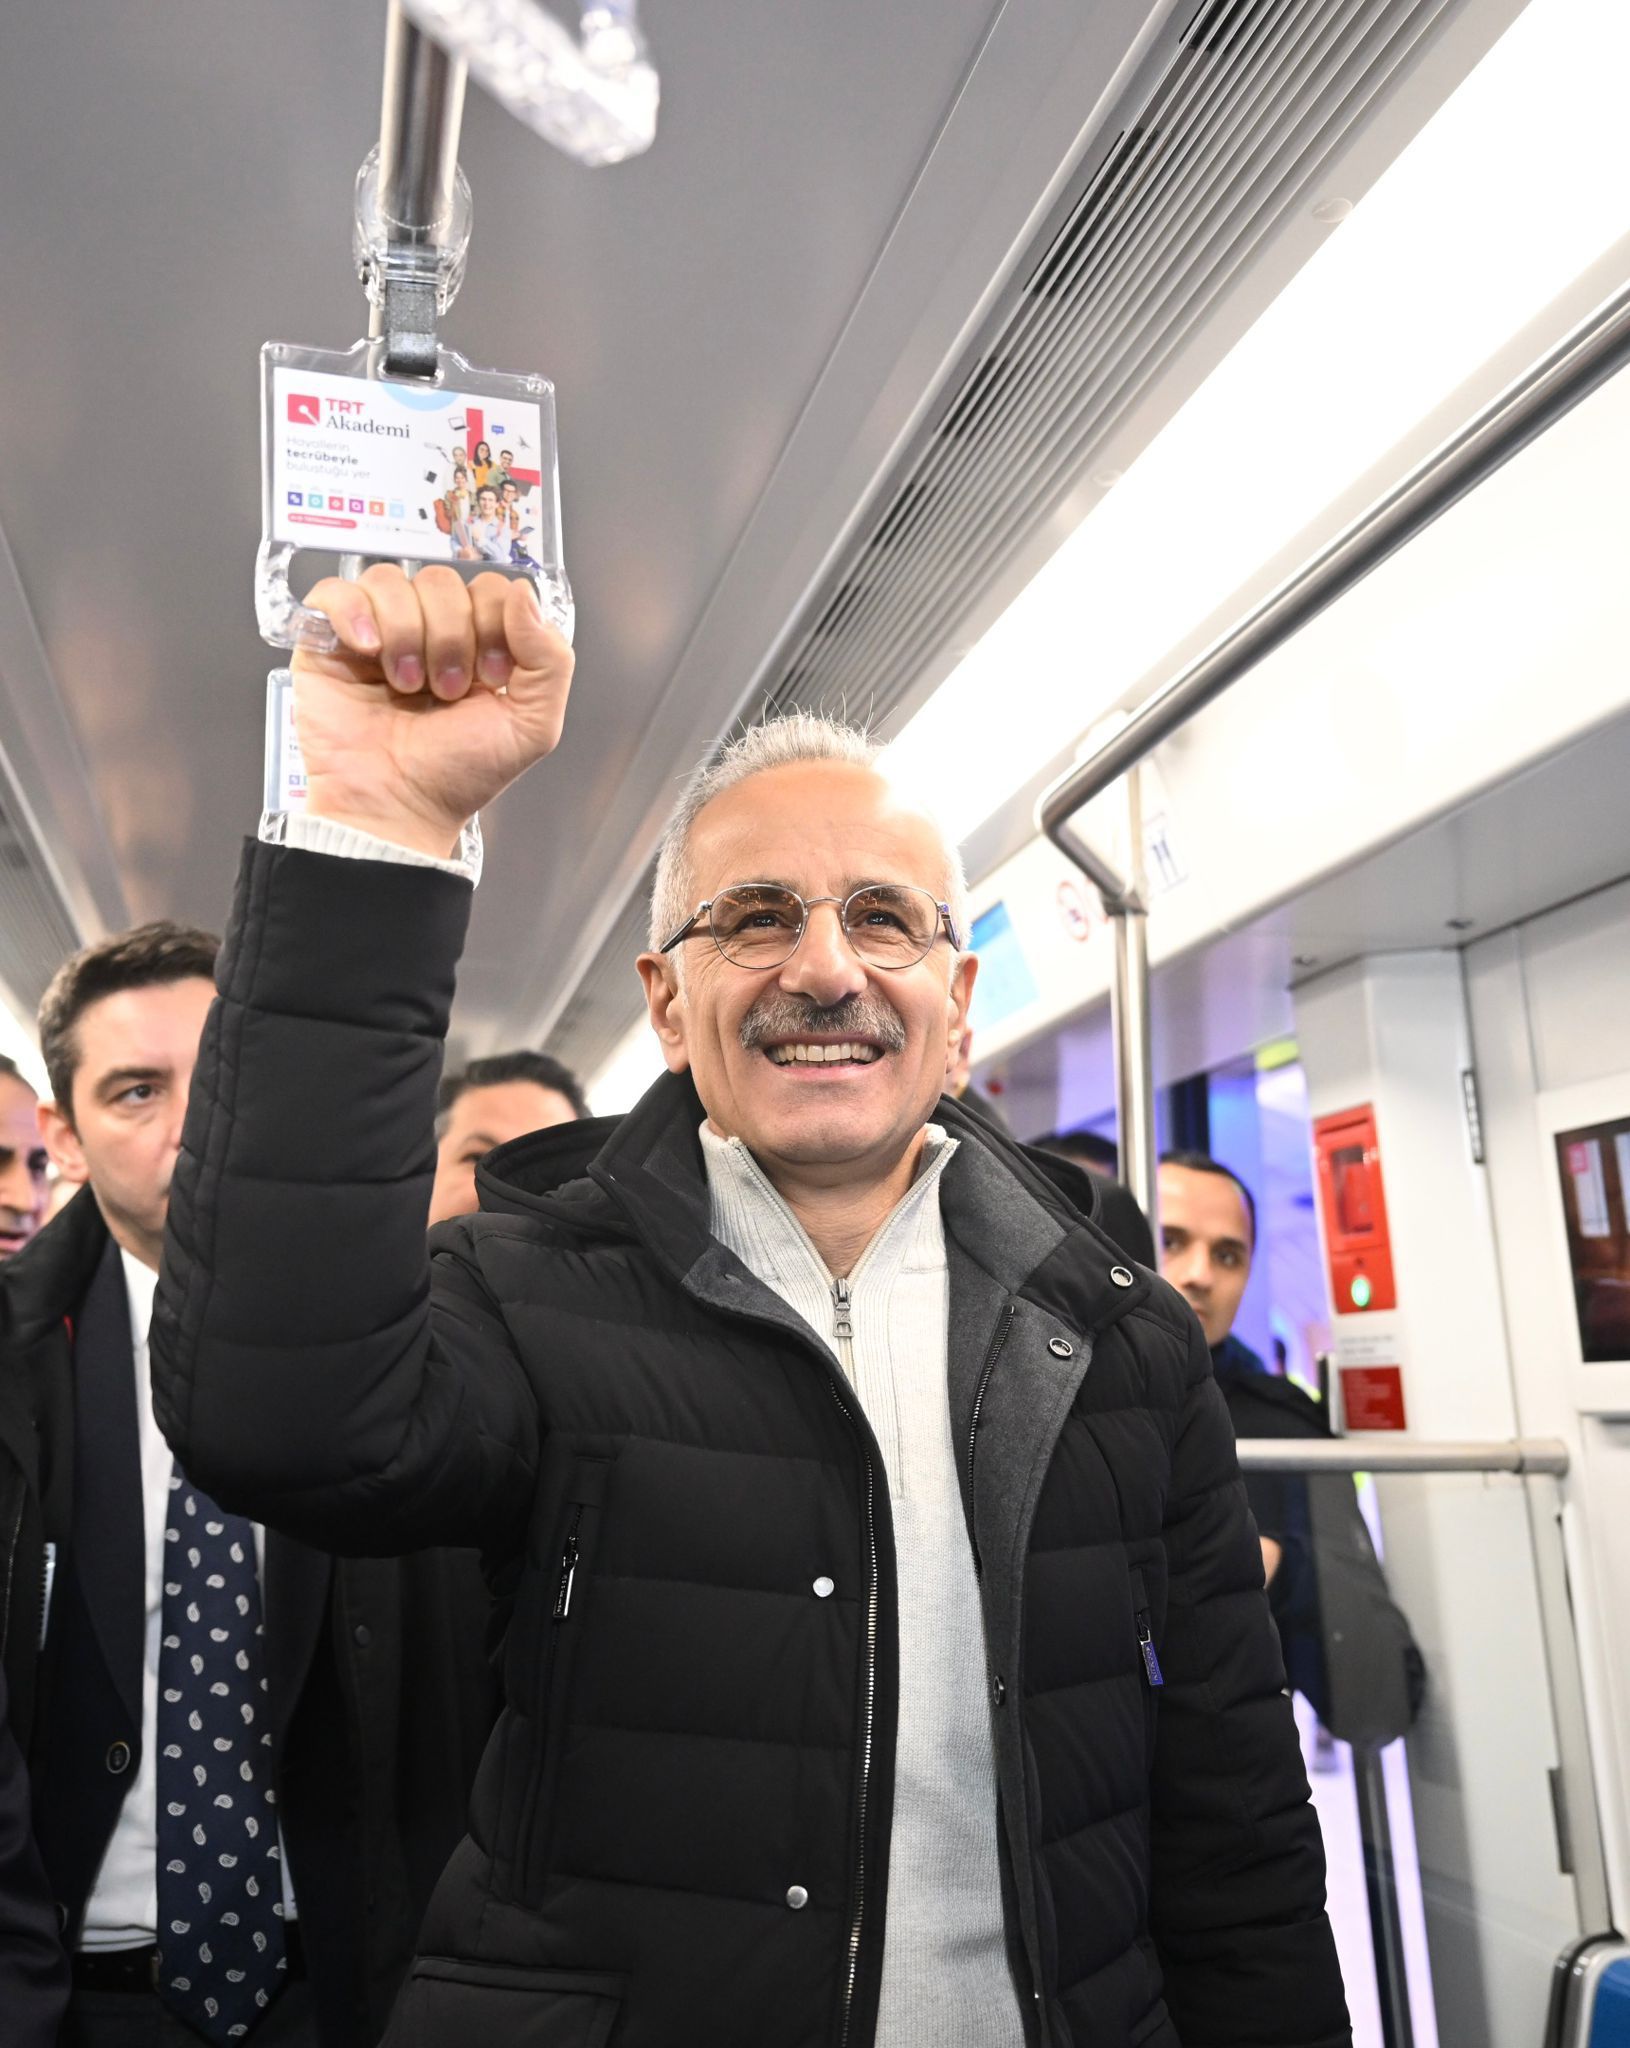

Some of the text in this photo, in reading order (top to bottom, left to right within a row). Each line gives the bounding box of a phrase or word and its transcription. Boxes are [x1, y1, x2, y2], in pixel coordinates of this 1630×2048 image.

[325, 398, 365, 415] TRT
[326, 415, 410, 439] Akademi
[287, 436, 350, 451] Hayallerin
[287, 449, 358, 465] tecrübeyle
